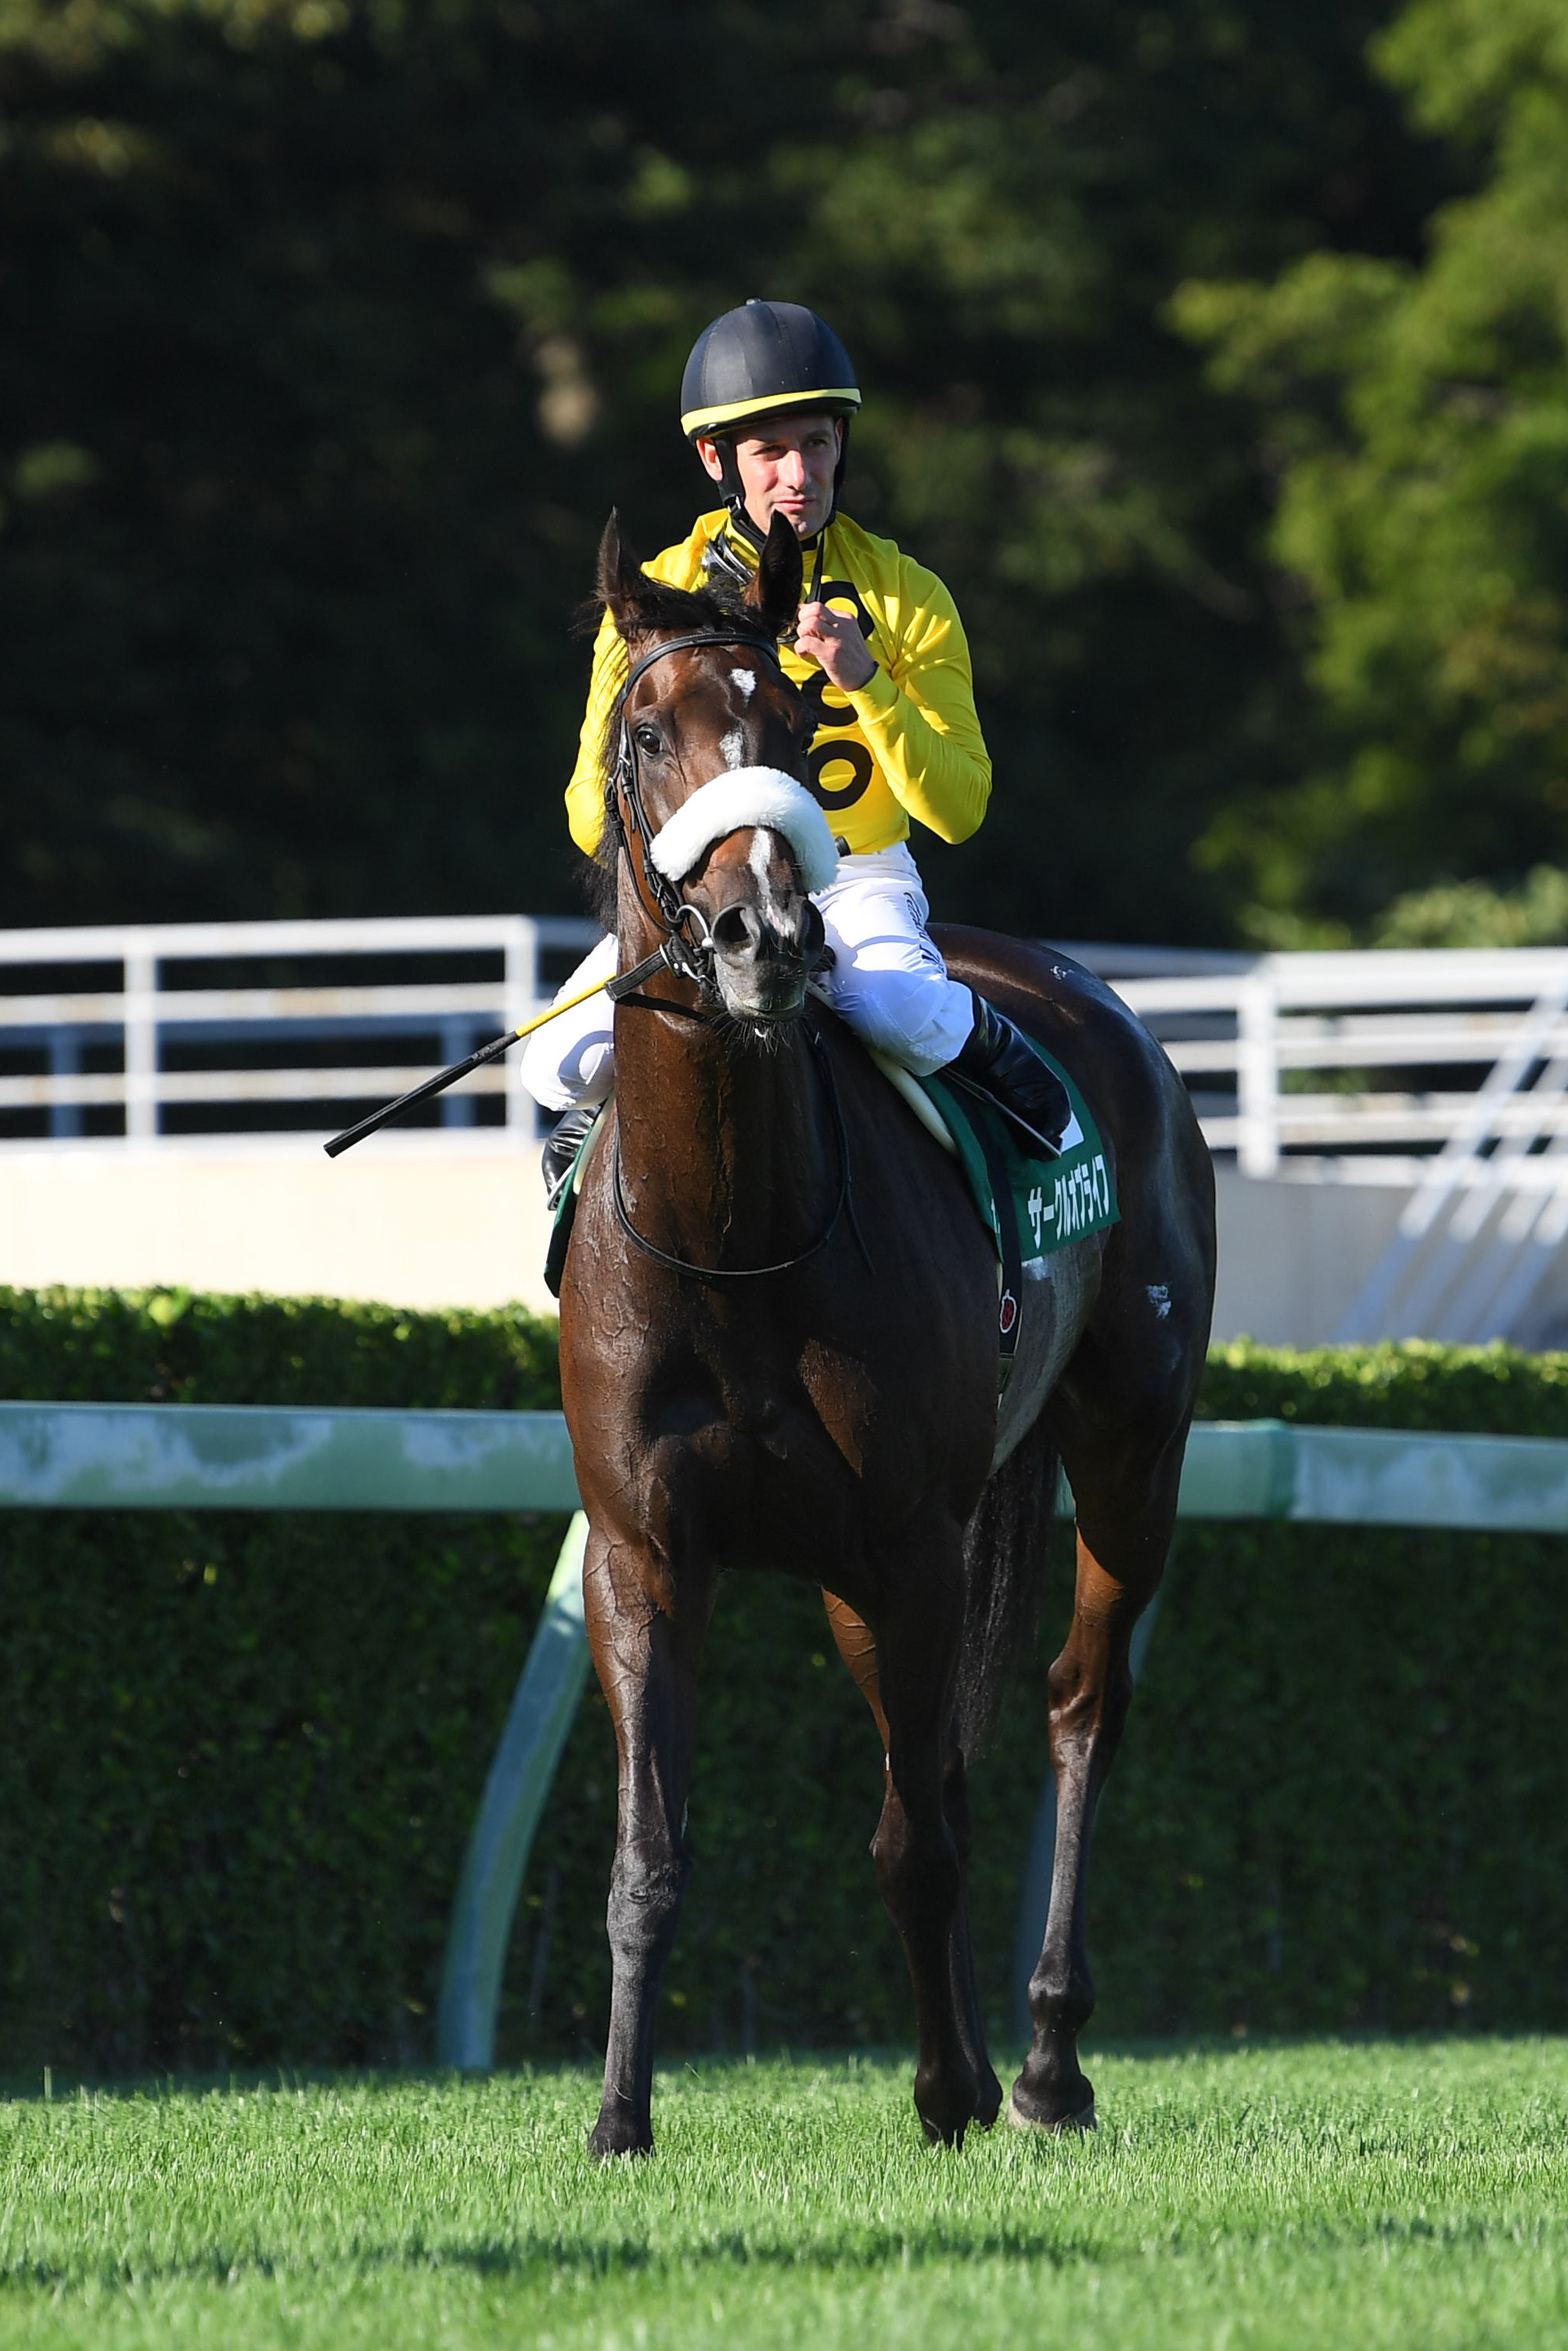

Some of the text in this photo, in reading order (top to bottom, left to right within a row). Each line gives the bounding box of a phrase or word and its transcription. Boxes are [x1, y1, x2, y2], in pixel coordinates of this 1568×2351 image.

[1027, 1154, 1109, 1249] サークルオブライフ
